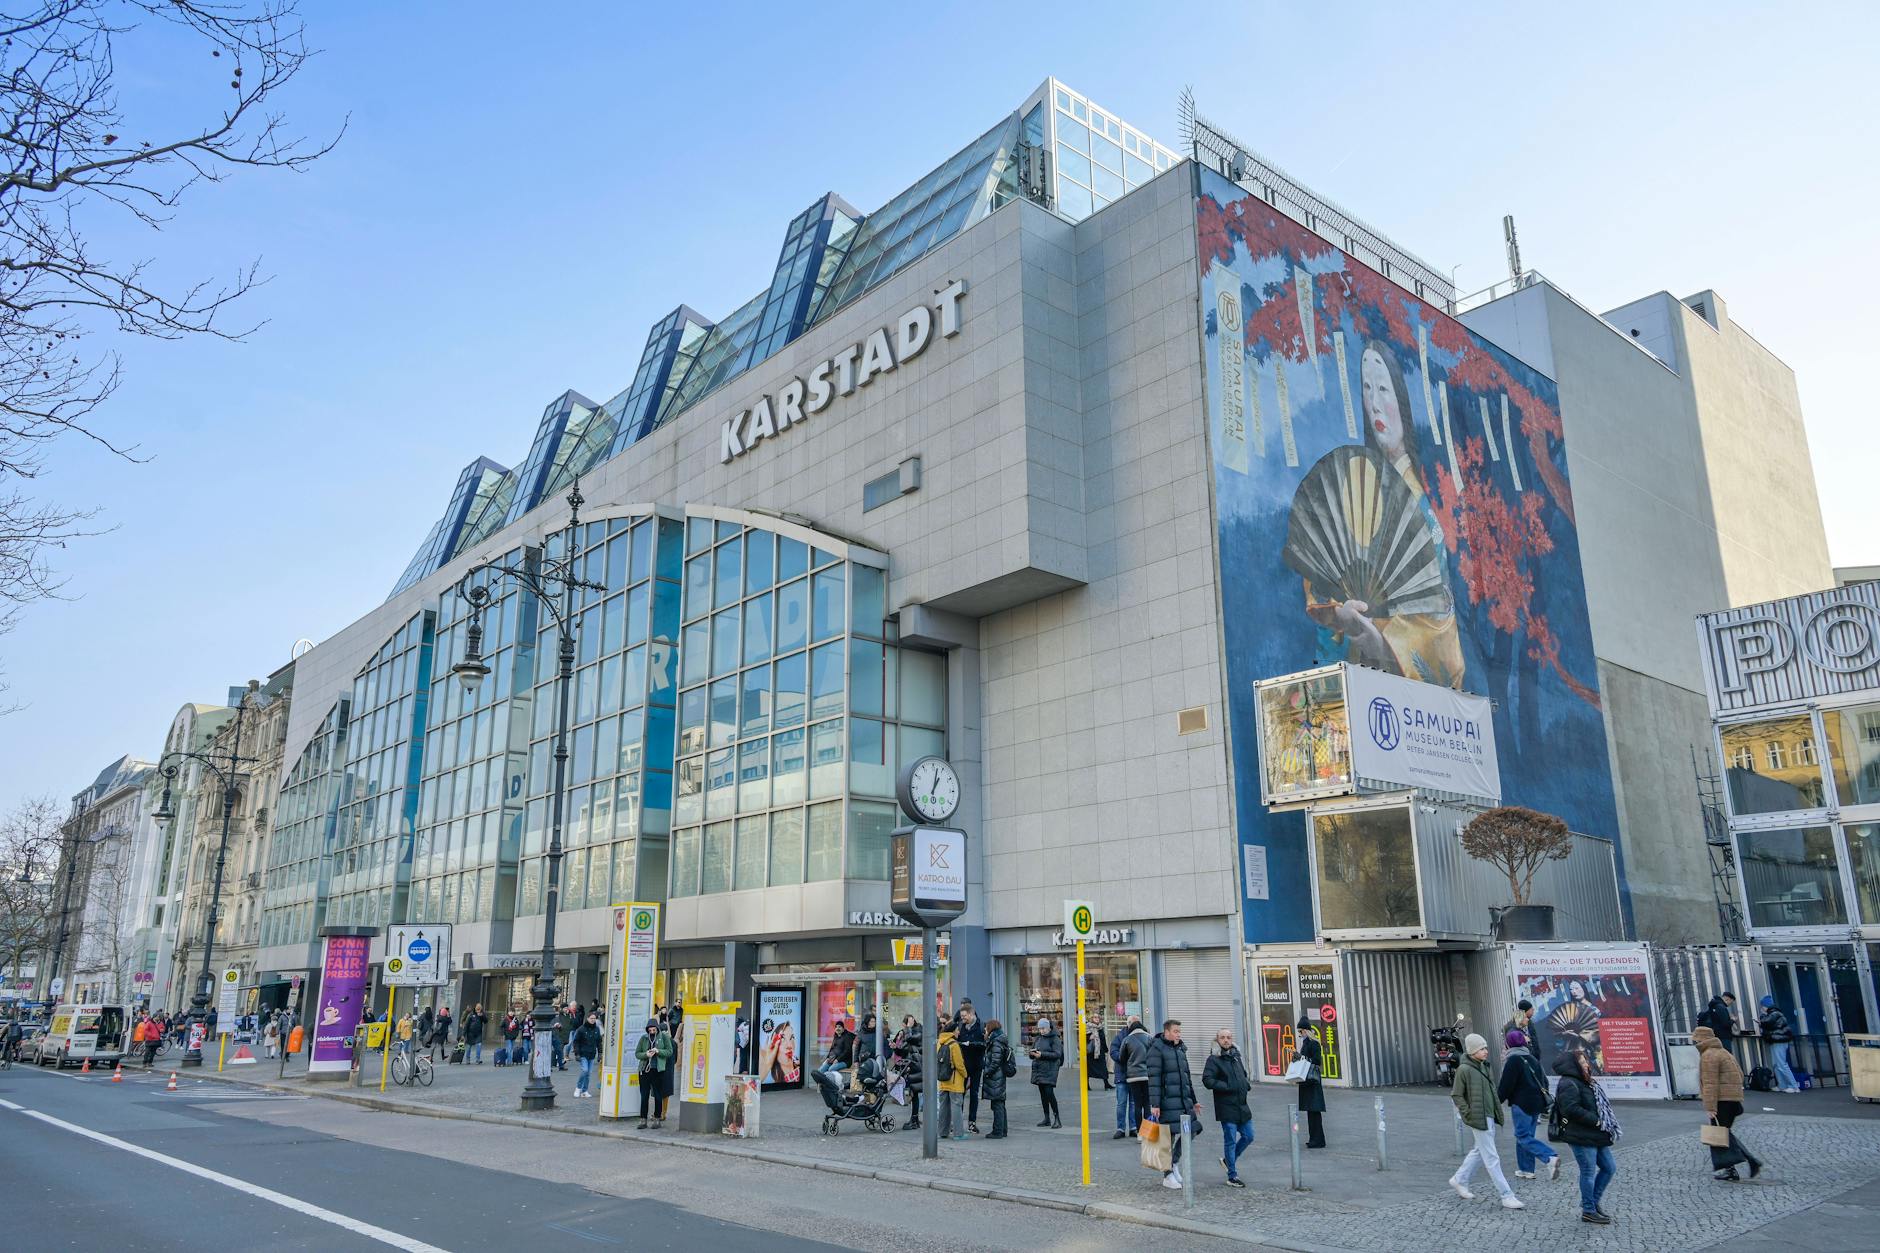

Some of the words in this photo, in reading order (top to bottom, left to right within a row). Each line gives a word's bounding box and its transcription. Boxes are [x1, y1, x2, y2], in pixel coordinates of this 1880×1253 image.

[719, 278, 968, 465] KARSTADT
[1233, 339, 1245, 441] SAMURAI
[1406, 730, 1447, 747] MUSEUM
[1449, 739, 1483, 755] BERLIN
[918, 874, 945, 884] KATRO
[327, 957, 363, 969] FAIR-
[326, 970, 361, 979] PRESSO
[1300, 973, 1332, 981] premium
[1300, 982, 1327, 990] korean
